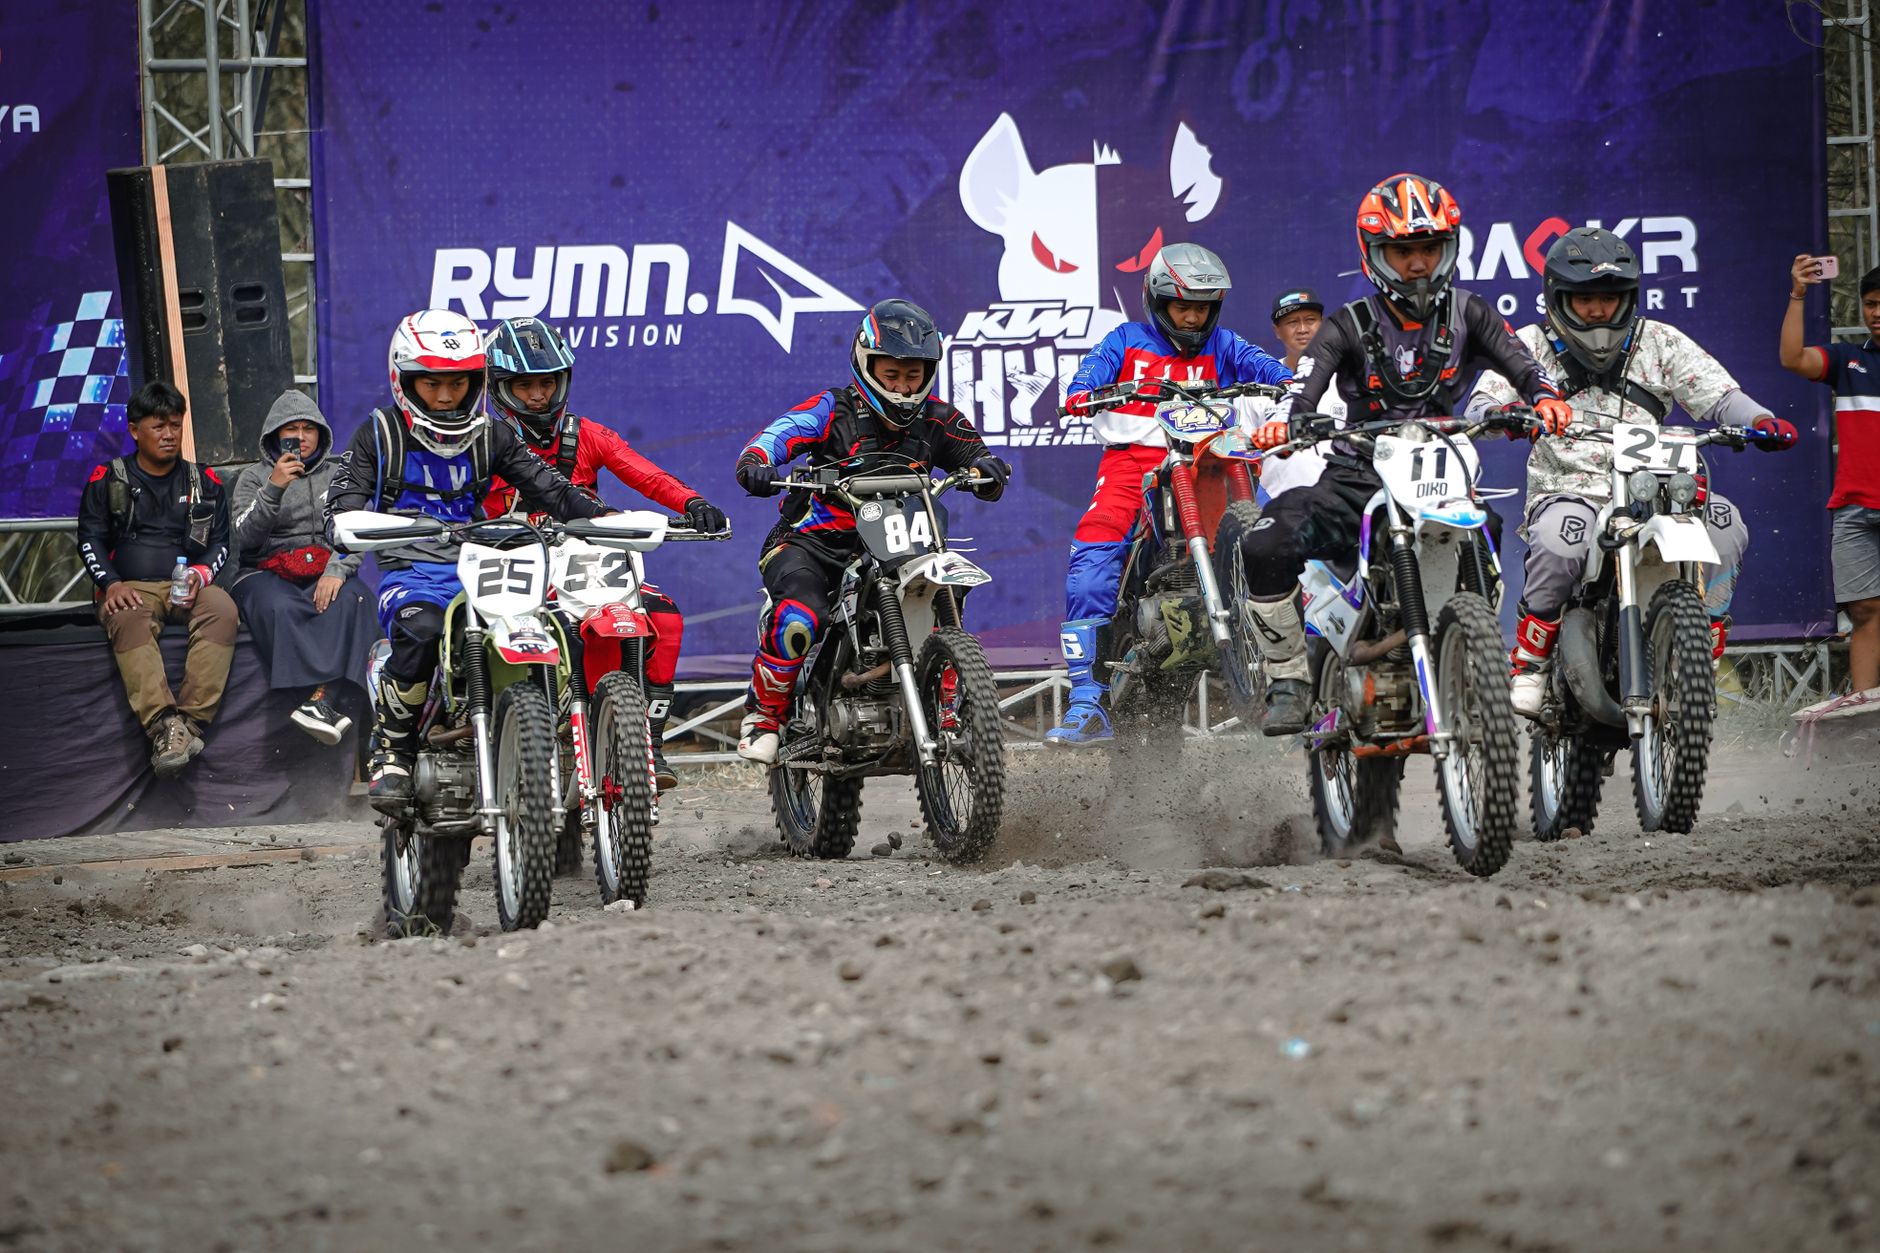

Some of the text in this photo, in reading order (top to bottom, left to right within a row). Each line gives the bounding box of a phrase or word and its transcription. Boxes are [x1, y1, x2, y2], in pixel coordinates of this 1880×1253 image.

[954, 301, 1092, 341] KTM
[1409, 446, 1448, 482] 11
[1415, 481, 1449, 499] DIKO
[883, 510, 932, 554] 84
[82, 542, 108, 580] ORCA
[212, 546, 228, 575] RCA
[477, 557, 536, 598] 25
[563, 551, 634, 593] 52
